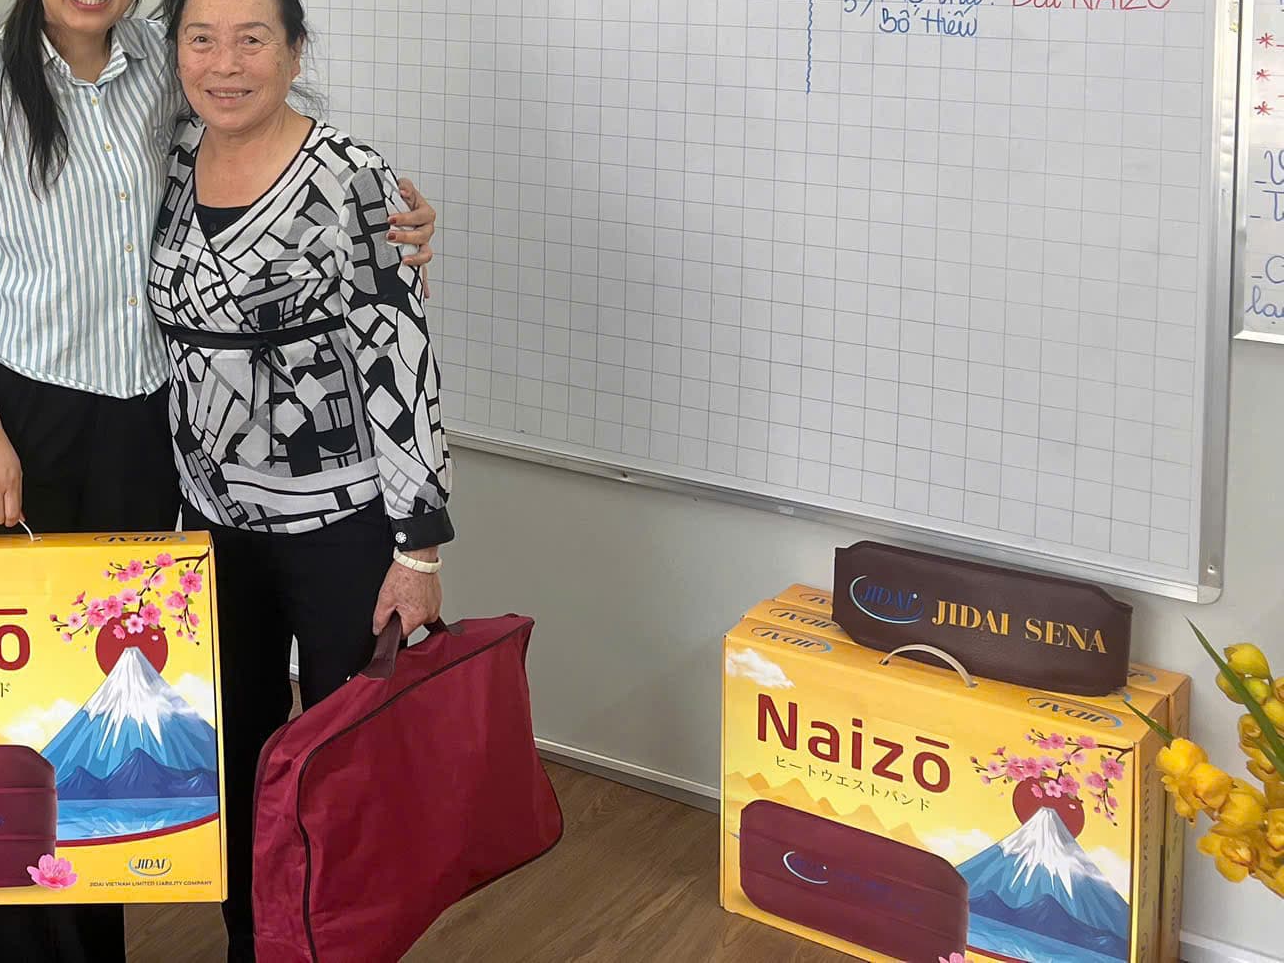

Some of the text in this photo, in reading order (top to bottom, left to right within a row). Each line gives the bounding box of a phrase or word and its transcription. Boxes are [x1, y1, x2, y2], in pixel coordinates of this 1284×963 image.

[932, 599, 1010, 636] JIDAI
[1024, 616, 1108, 654] SENA
[757, 693, 951, 793] Naizō
[135, 858, 167, 870] JIDAI
